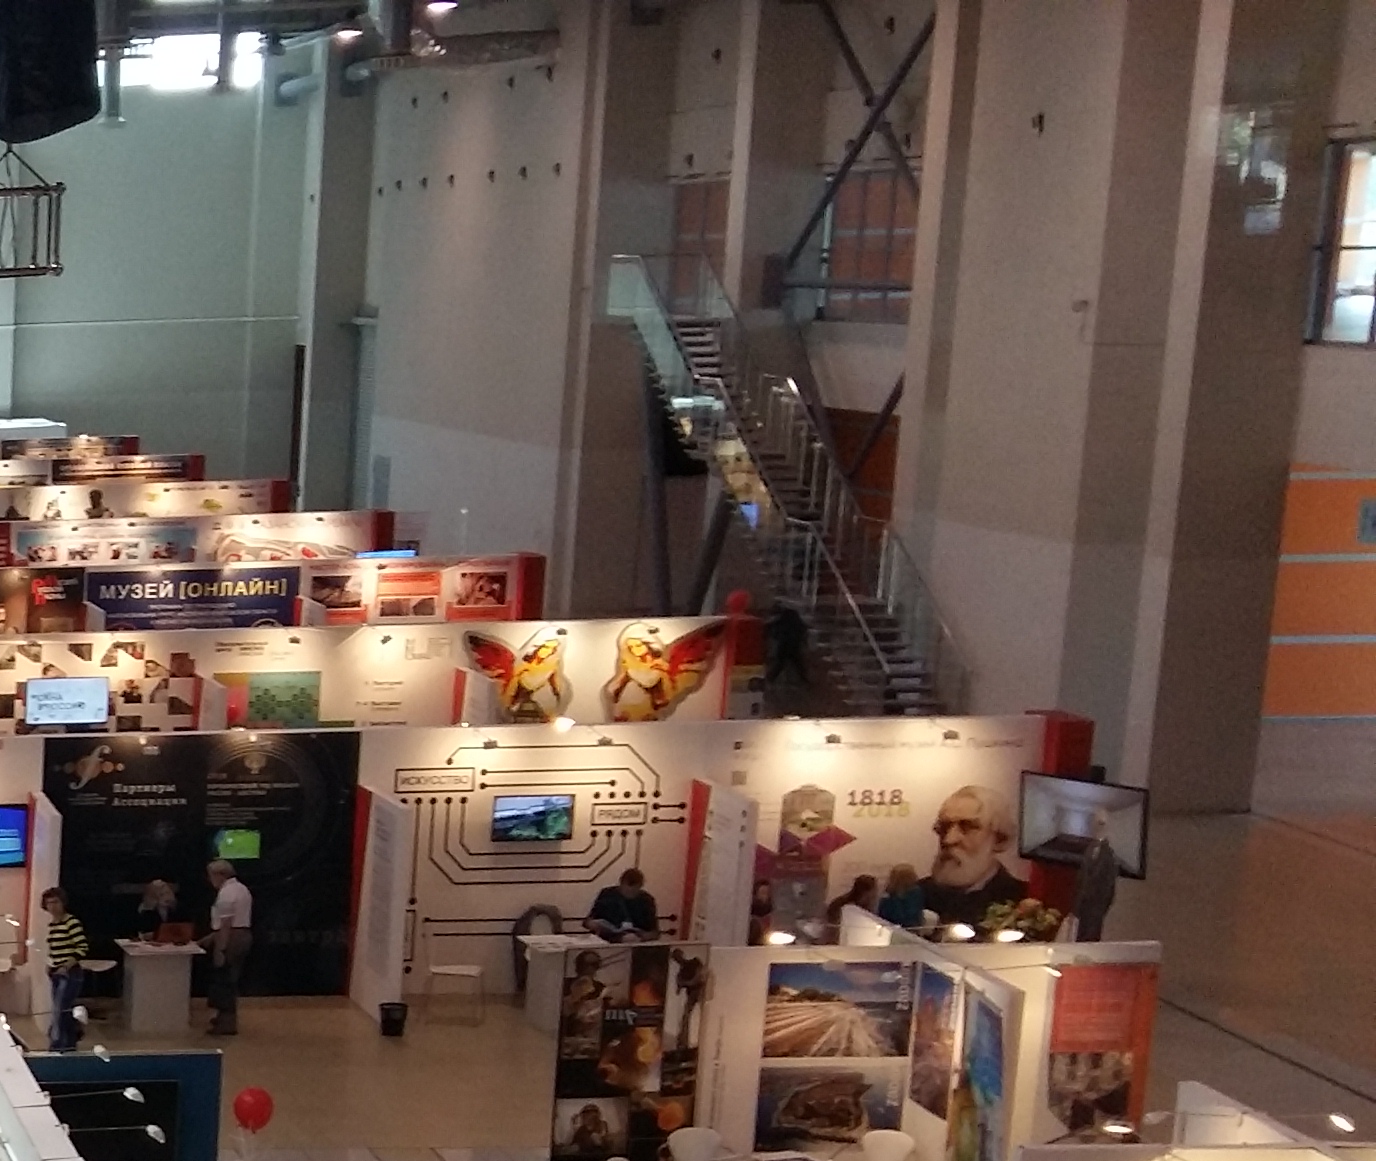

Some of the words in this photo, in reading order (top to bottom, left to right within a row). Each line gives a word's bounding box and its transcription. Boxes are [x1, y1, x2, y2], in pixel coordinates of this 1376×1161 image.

[99, 580, 174, 600] МУЗЕЙ
[399, 774, 471, 787] ИСКУССТВО
[846, 788, 904, 806] 1818
[597, 807, 642, 821] РЯДОМ
